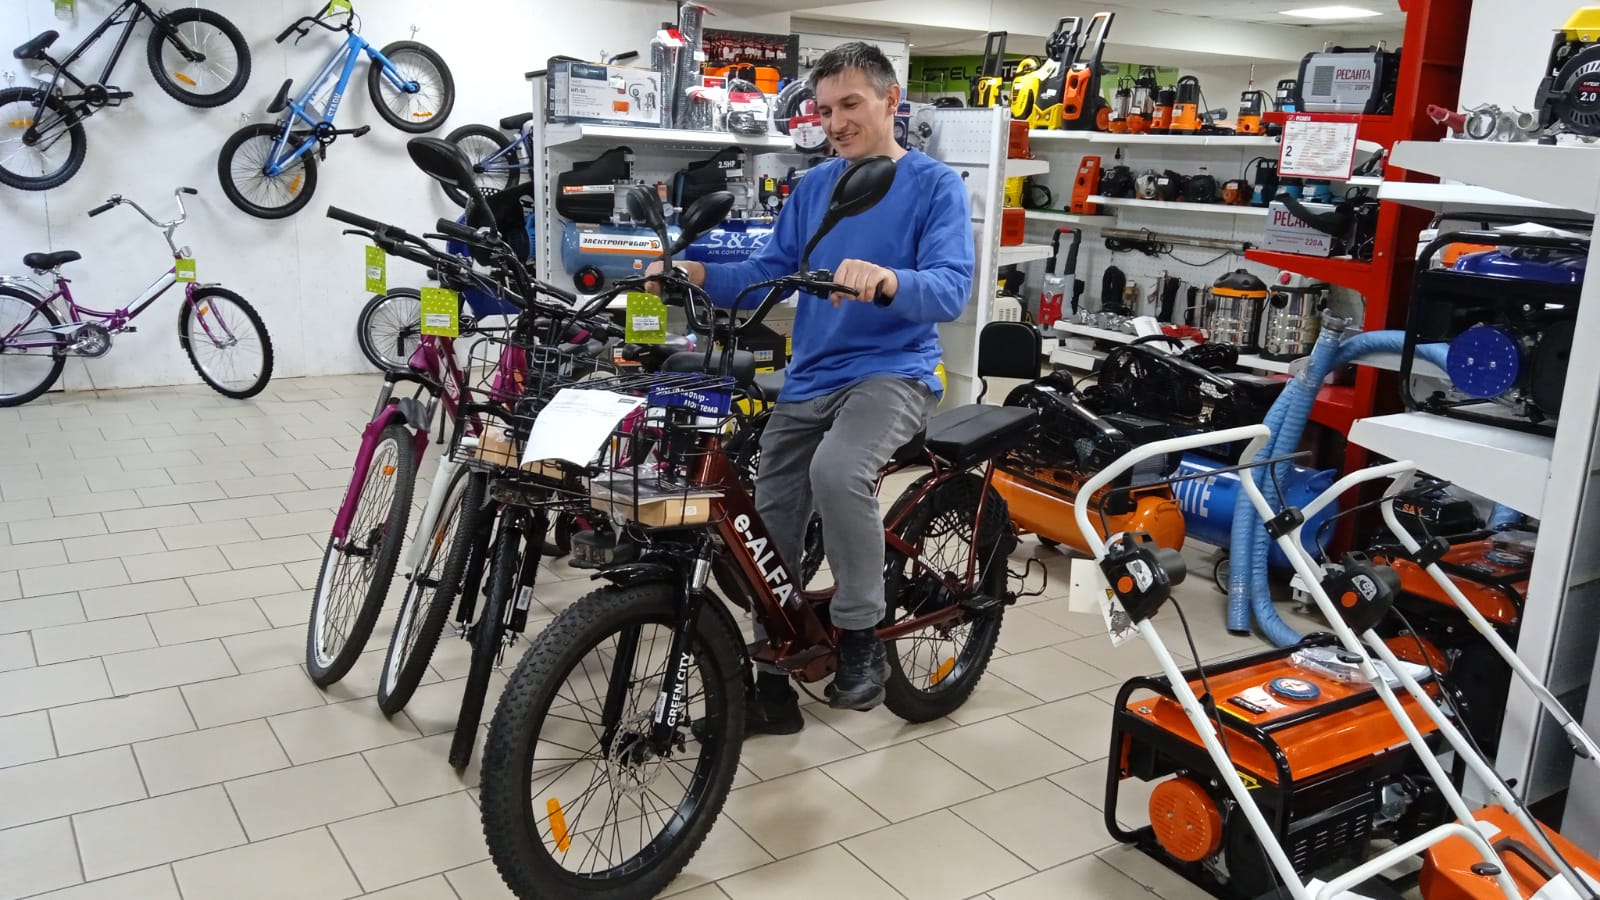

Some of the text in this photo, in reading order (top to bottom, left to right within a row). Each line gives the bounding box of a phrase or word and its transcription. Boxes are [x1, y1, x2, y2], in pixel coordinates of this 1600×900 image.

[1336, 69, 1371, 80] РЕСАНТА
[1580, 91, 1597, 102] 2.0
[1285, 145, 1293, 157] 2
[718, 160, 736, 169] 2.5HP
[583, 238, 650, 247] ЭЛЕКТРОПРИБОР
[726, 231, 746, 249] &
[734, 514, 793, 607] e-ALFA
[667, 652, 691, 727] GREEN CITY
